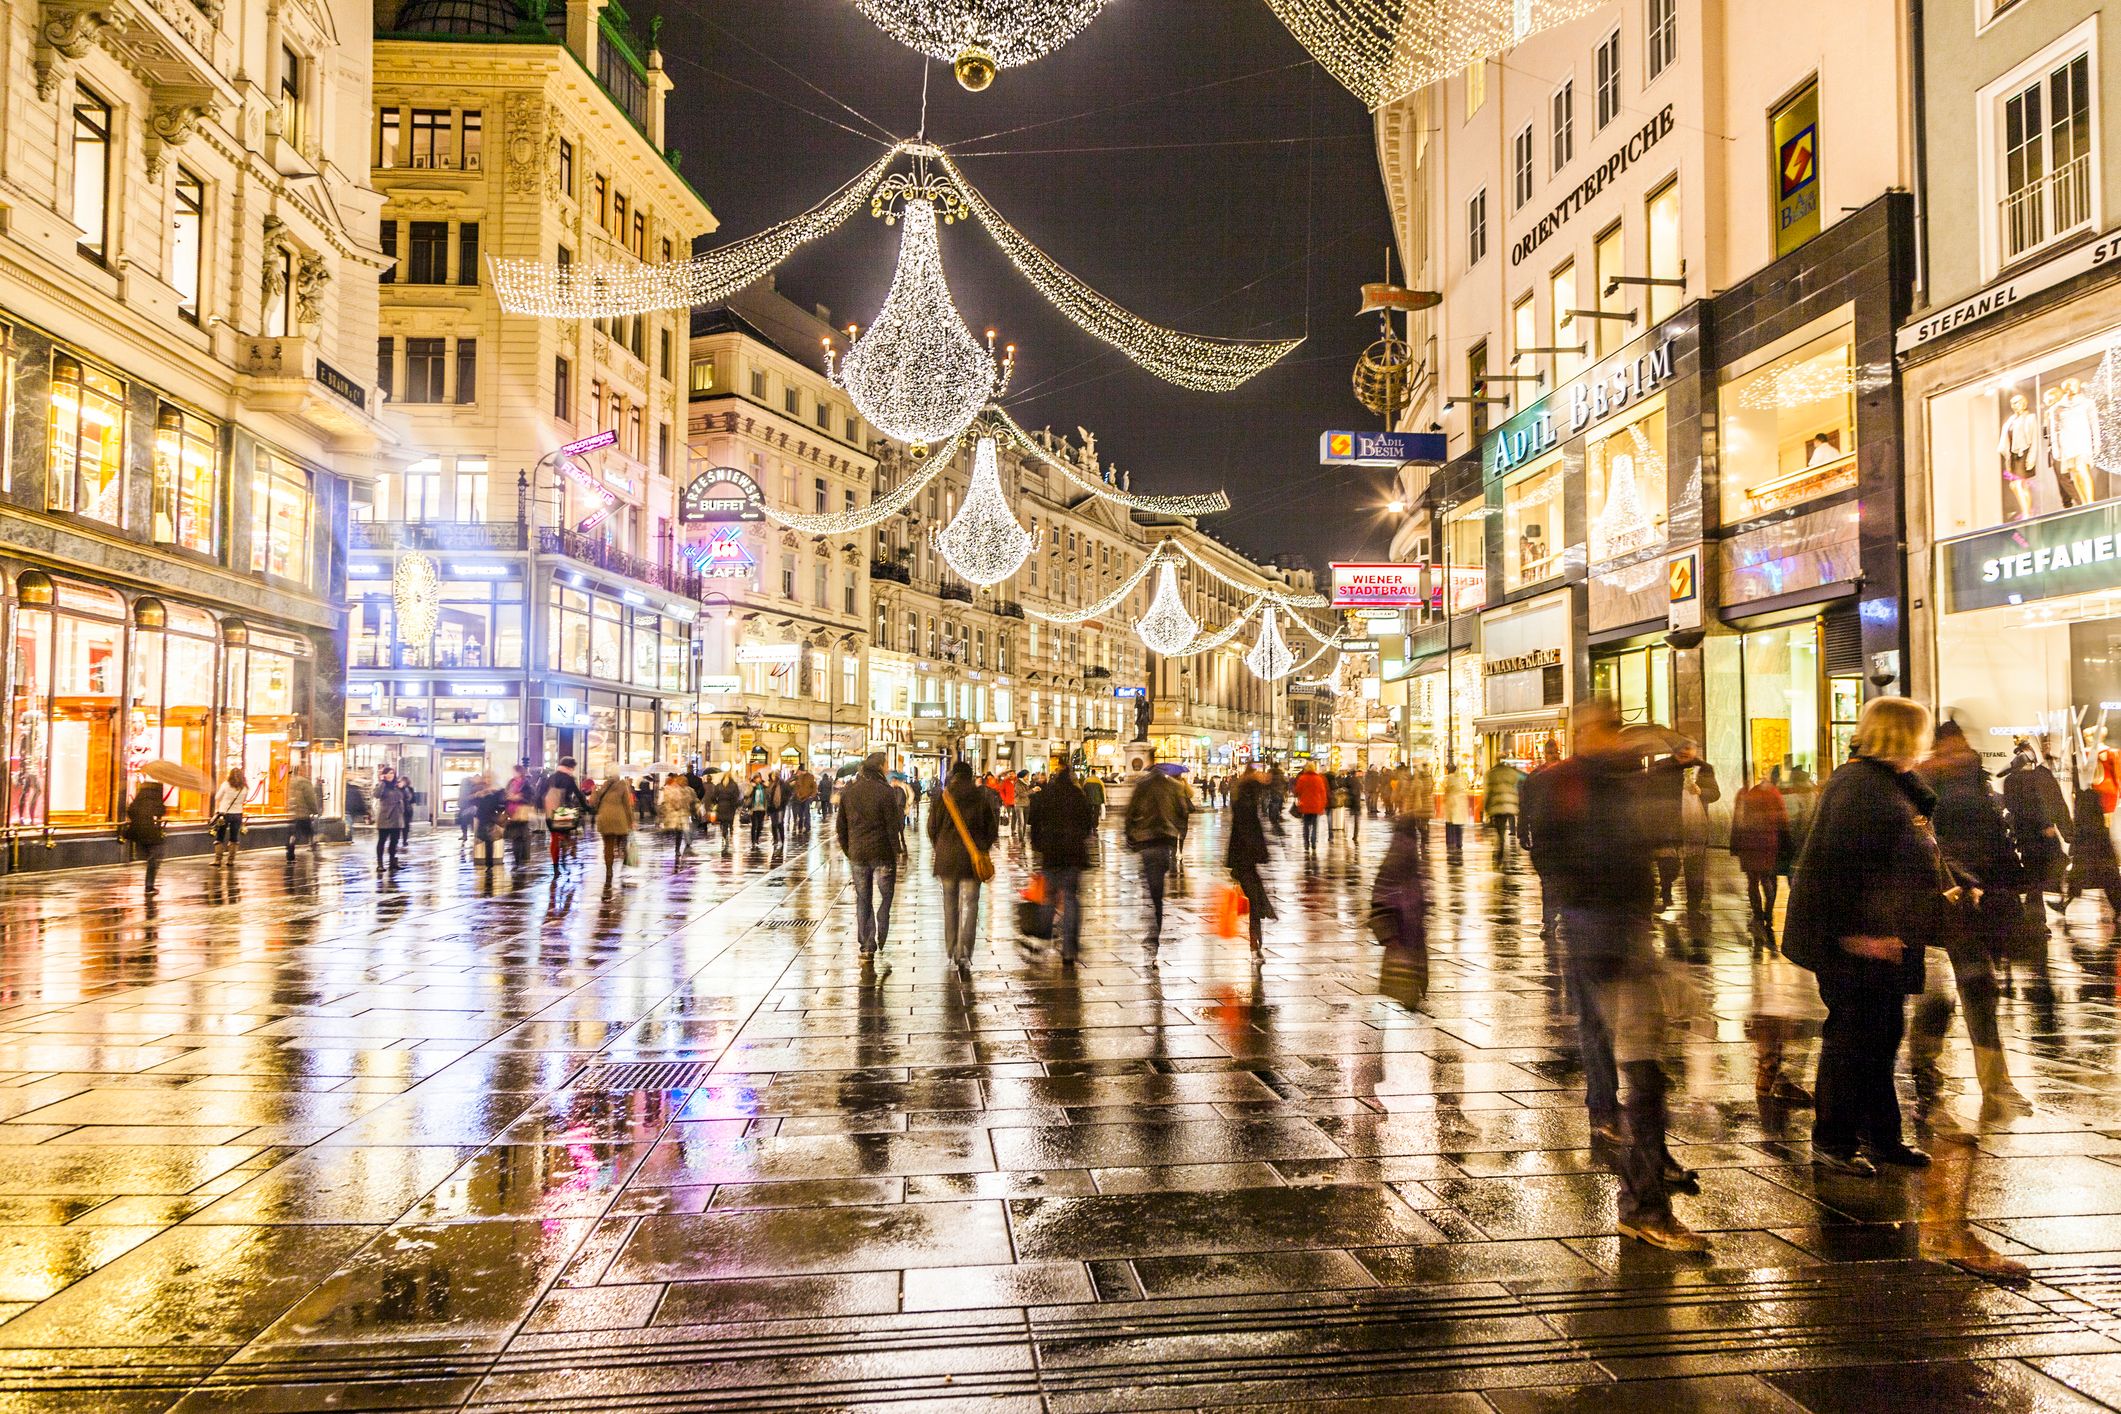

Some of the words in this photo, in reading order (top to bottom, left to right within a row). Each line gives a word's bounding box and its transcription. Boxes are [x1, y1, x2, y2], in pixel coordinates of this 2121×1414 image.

[1512, 103, 1675, 266] ORIENTTEPPICHE
[1917, 286, 2018, 342] STEFANEL
[1492, 410, 1557, 477] ADIL
[1569, 338, 1676, 434] BESIM
[1359, 438, 1404, 458] BESIM
[1377, 433, 1405, 447] ADIL
[700, 500, 746, 511] BUFFET
[1353, 575, 1402, 584] WIENER
[868, 717, 914, 743] LISKA
